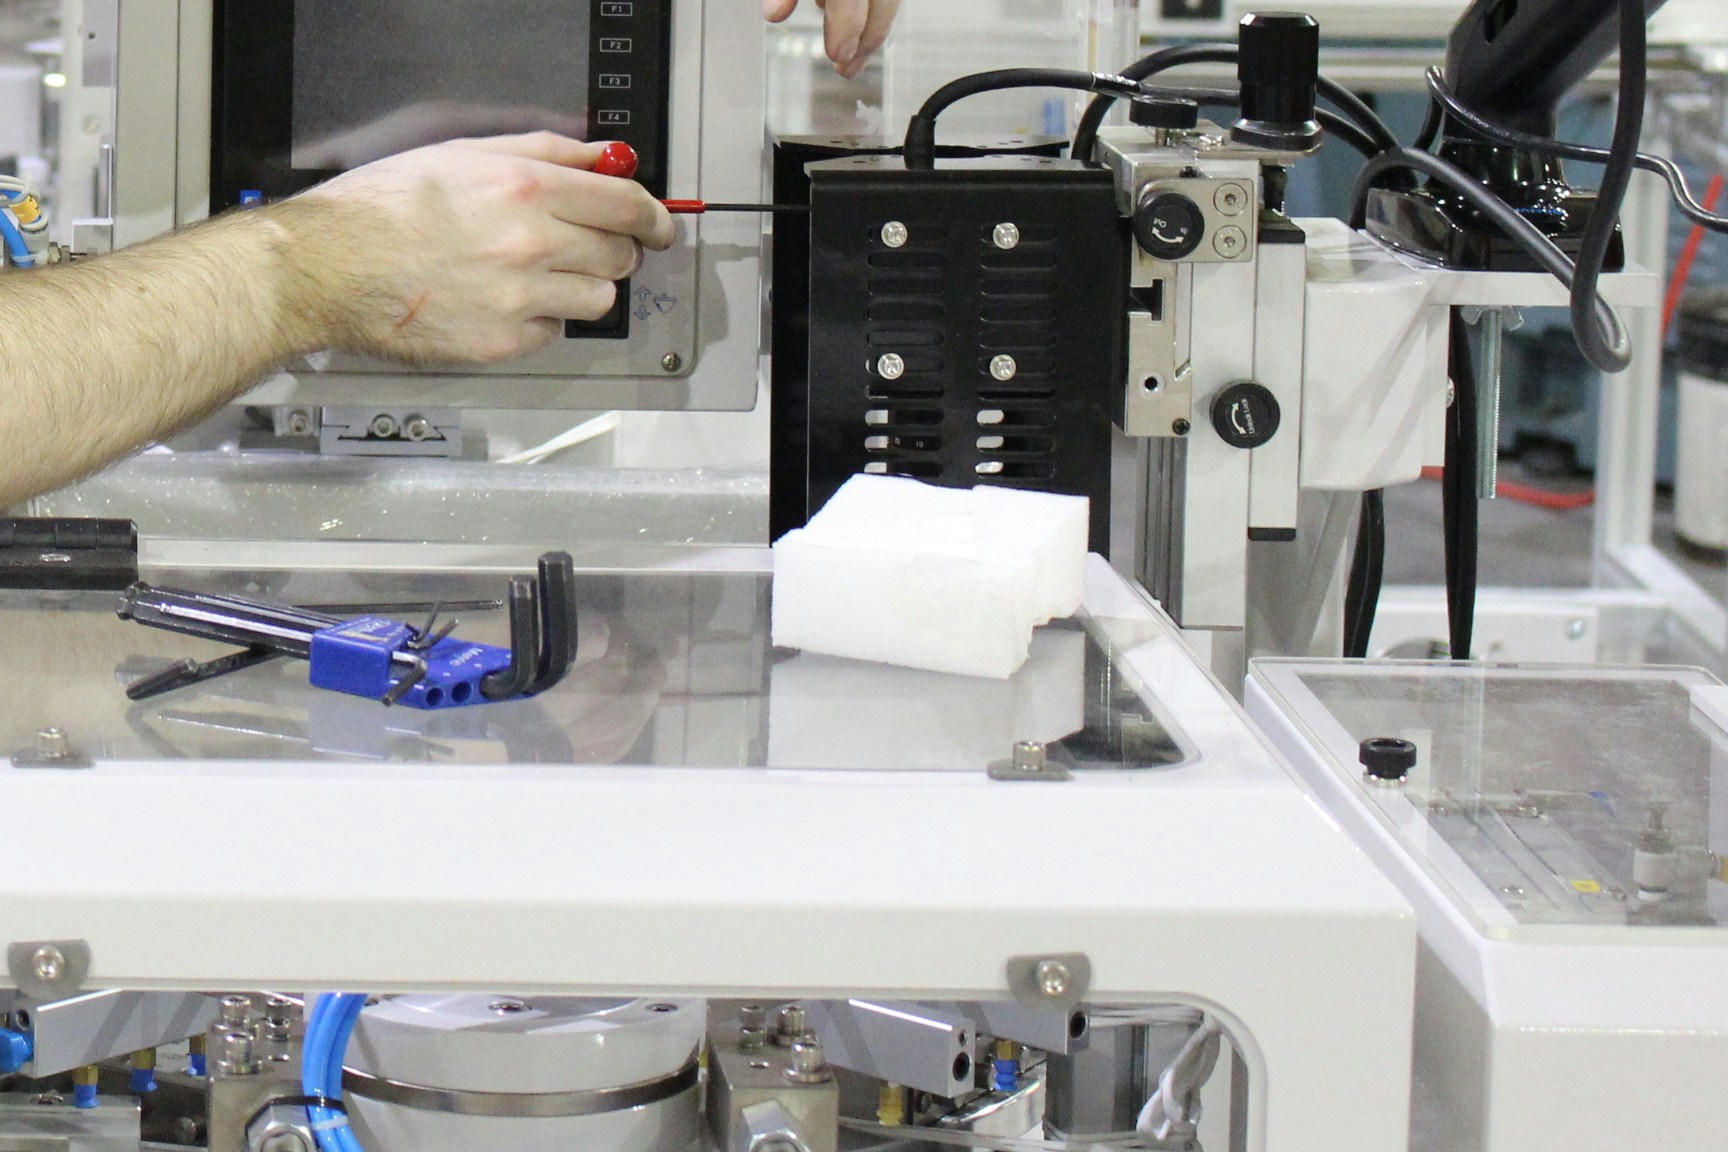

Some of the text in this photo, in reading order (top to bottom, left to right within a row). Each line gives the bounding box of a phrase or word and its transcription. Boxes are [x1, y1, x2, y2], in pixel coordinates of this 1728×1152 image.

[611, 5, 622, 13] F1
[610, 41, 621, 49] F2
[609, 77, 620, 85] F3
[608, 113, 619, 121] F4
[1152, 217, 1167, 228] Out
